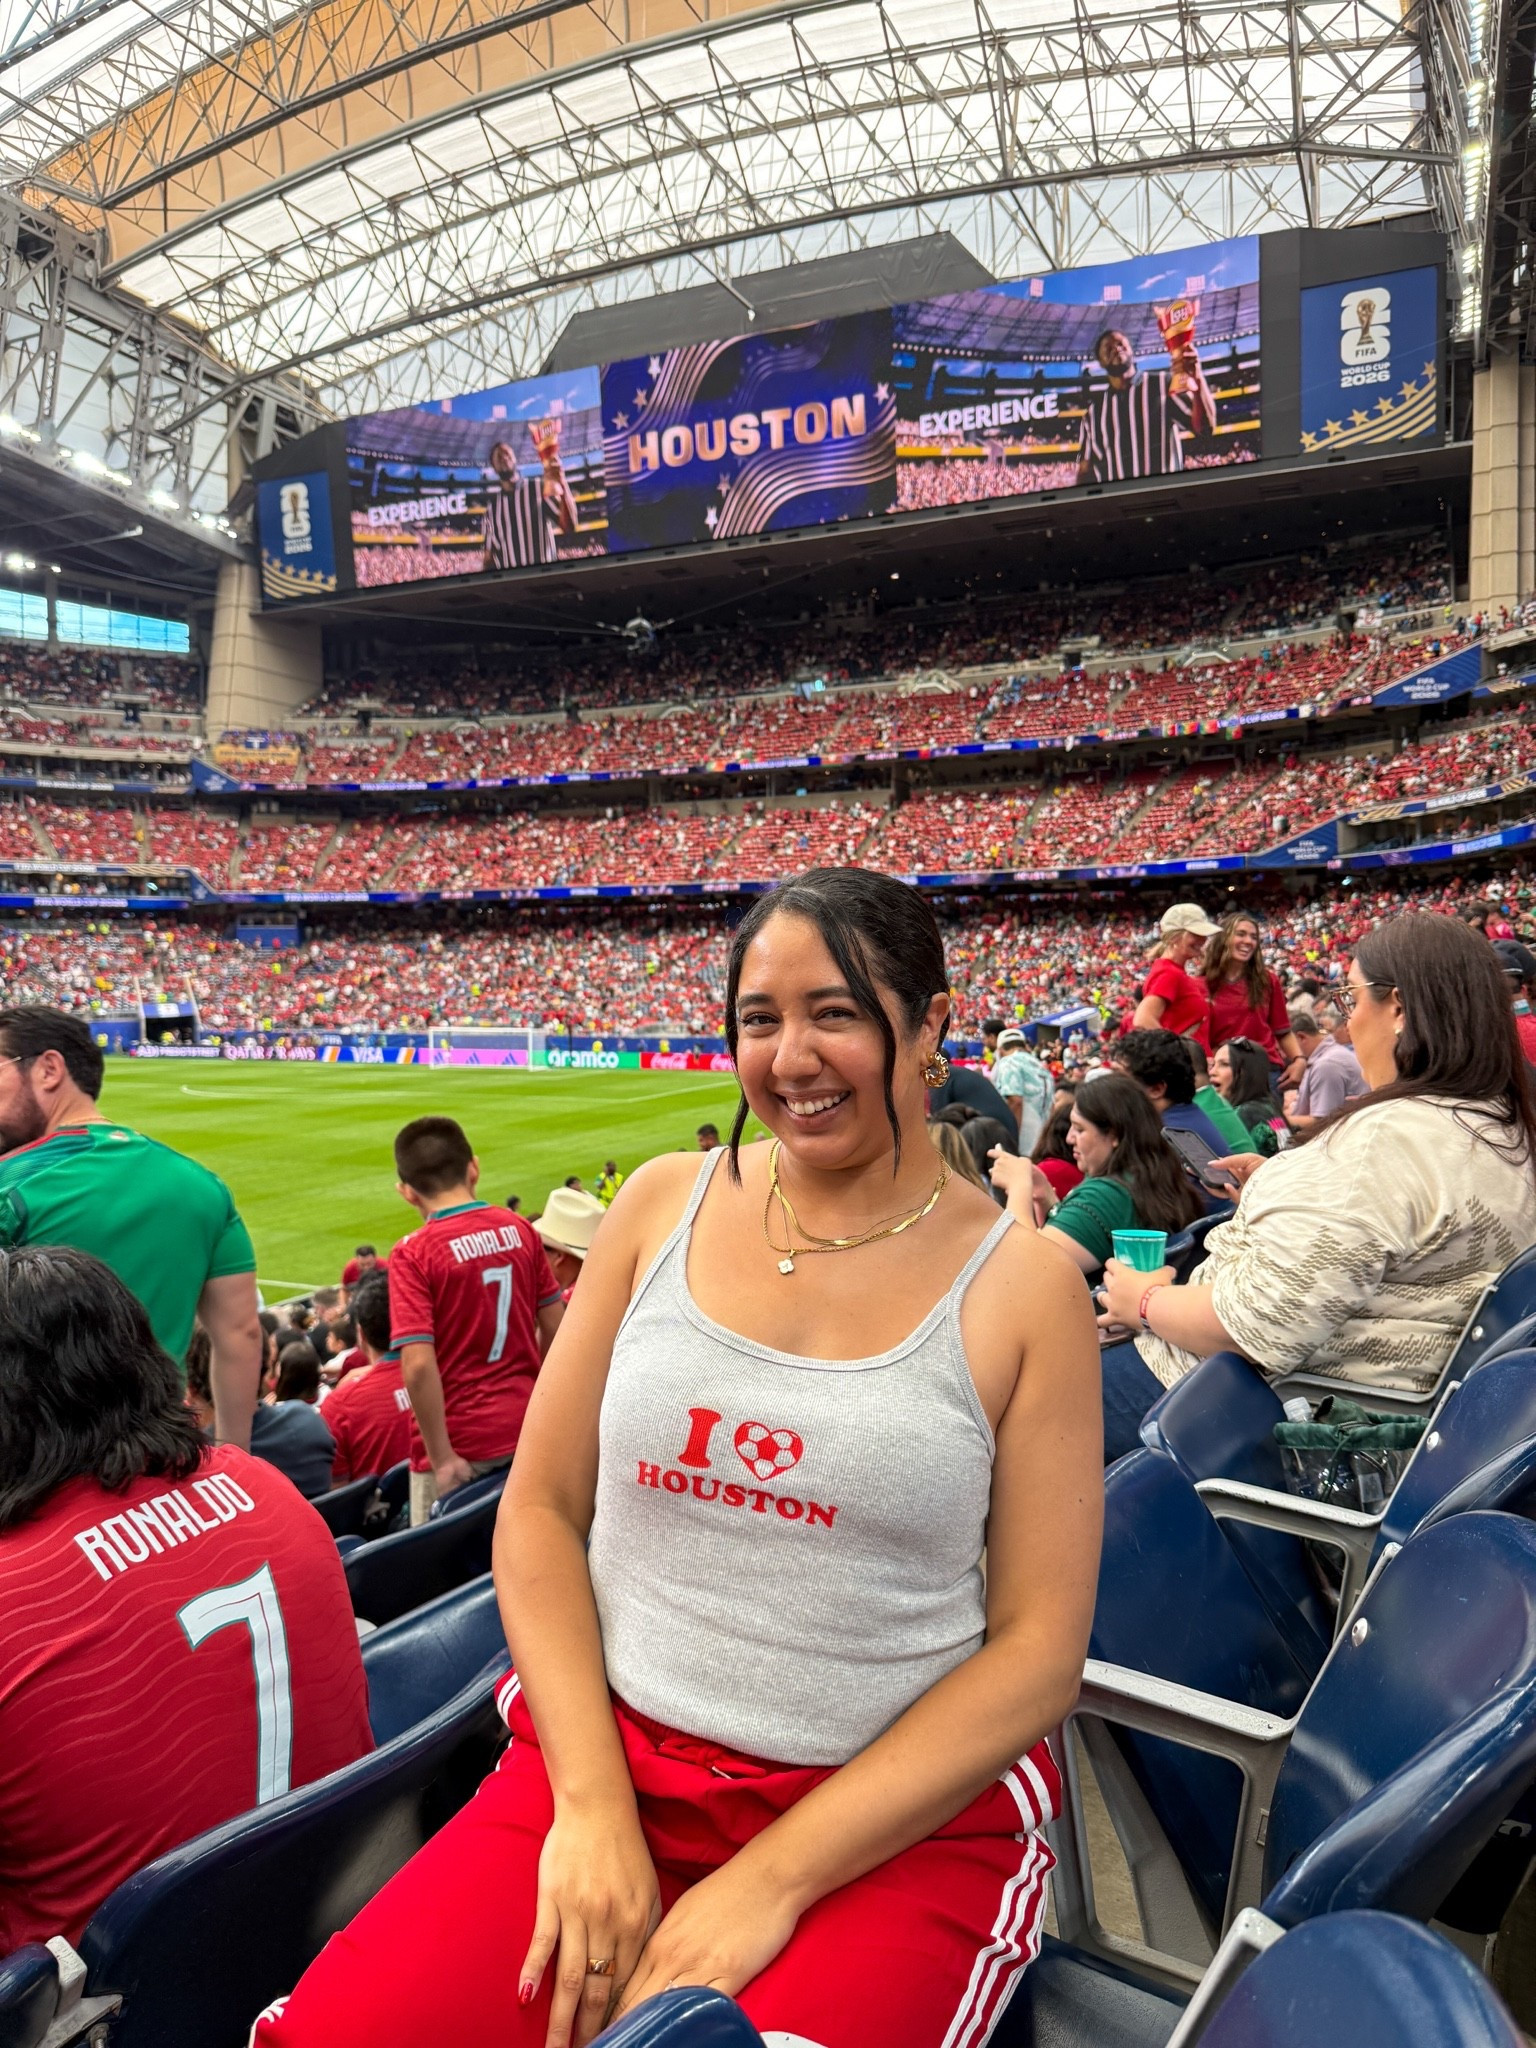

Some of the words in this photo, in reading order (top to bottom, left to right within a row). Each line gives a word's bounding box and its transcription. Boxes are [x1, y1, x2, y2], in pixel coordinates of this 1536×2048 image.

[1341, 365, 1372, 376] WORLD
[1373, 362, 1390, 371] CUP
[1355, 347, 1377, 358] FIFA
[1341, 370, 1390, 388] 2026
[628, 393, 867, 473] HOUSTON
[919, 393, 1060, 438] EXPERIENCE
[367, 492, 468, 527] EXPERIENCE
[351, 1047, 384, 1063] VISA
[547, 1051, 619, 1068] aramco
[449, 1225, 523, 1264] RONALDO
[482, 1264, 513, 1364] 7
[677, 1407, 722, 1469] I
[637, 1461, 839, 1529] HOUSTON
[74, 1472, 256, 1581] RONALDO
[176, 1560, 293, 1805] 7
